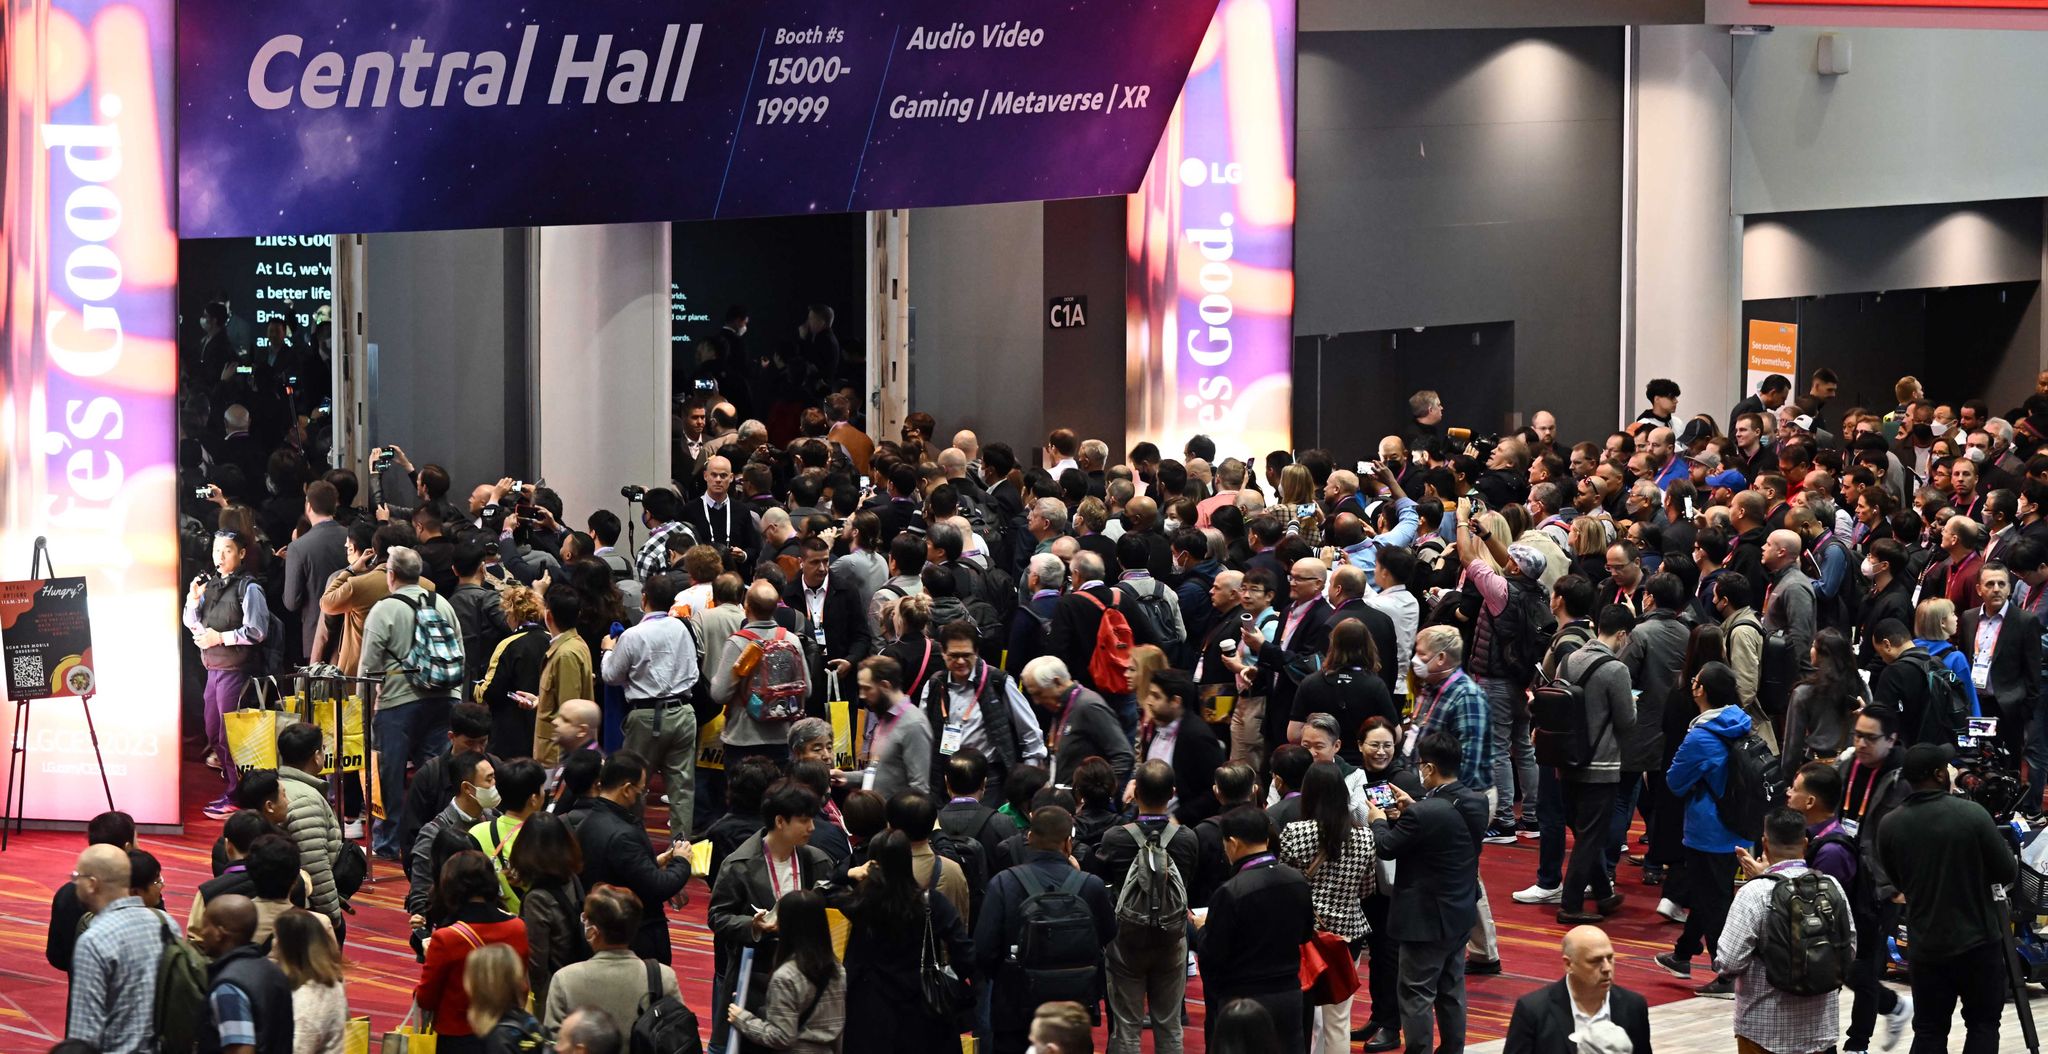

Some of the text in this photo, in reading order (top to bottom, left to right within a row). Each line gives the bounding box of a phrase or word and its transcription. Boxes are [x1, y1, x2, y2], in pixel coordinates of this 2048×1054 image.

[774, 25, 845, 45] Booth #s
[906, 21, 1045, 50] Audio Video
[247, 24, 704, 110] Central Hall
[767, 56, 851, 85] 15000-
[756, 96, 830, 125] 19999
[889, 91, 975, 123] Gaming
[989, 91, 1104, 115] Metaverse
[1117, 85, 1151, 109] XR
[1210, 162, 1243, 184] LG
[41, 93, 124, 377] Good.
[255, 262, 272, 275] At
[275, 262, 297, 278] LG,
[255, 286, 332, 299] a better life
[1184, 212, 1234, 367] Good.
[1050, 303, 1086, 328] C1A
[1751, 341, 1793, 355] See something.
[1751, 355, 1792, 369] Say something.
[41, 583, 84, 599] Hungry?
